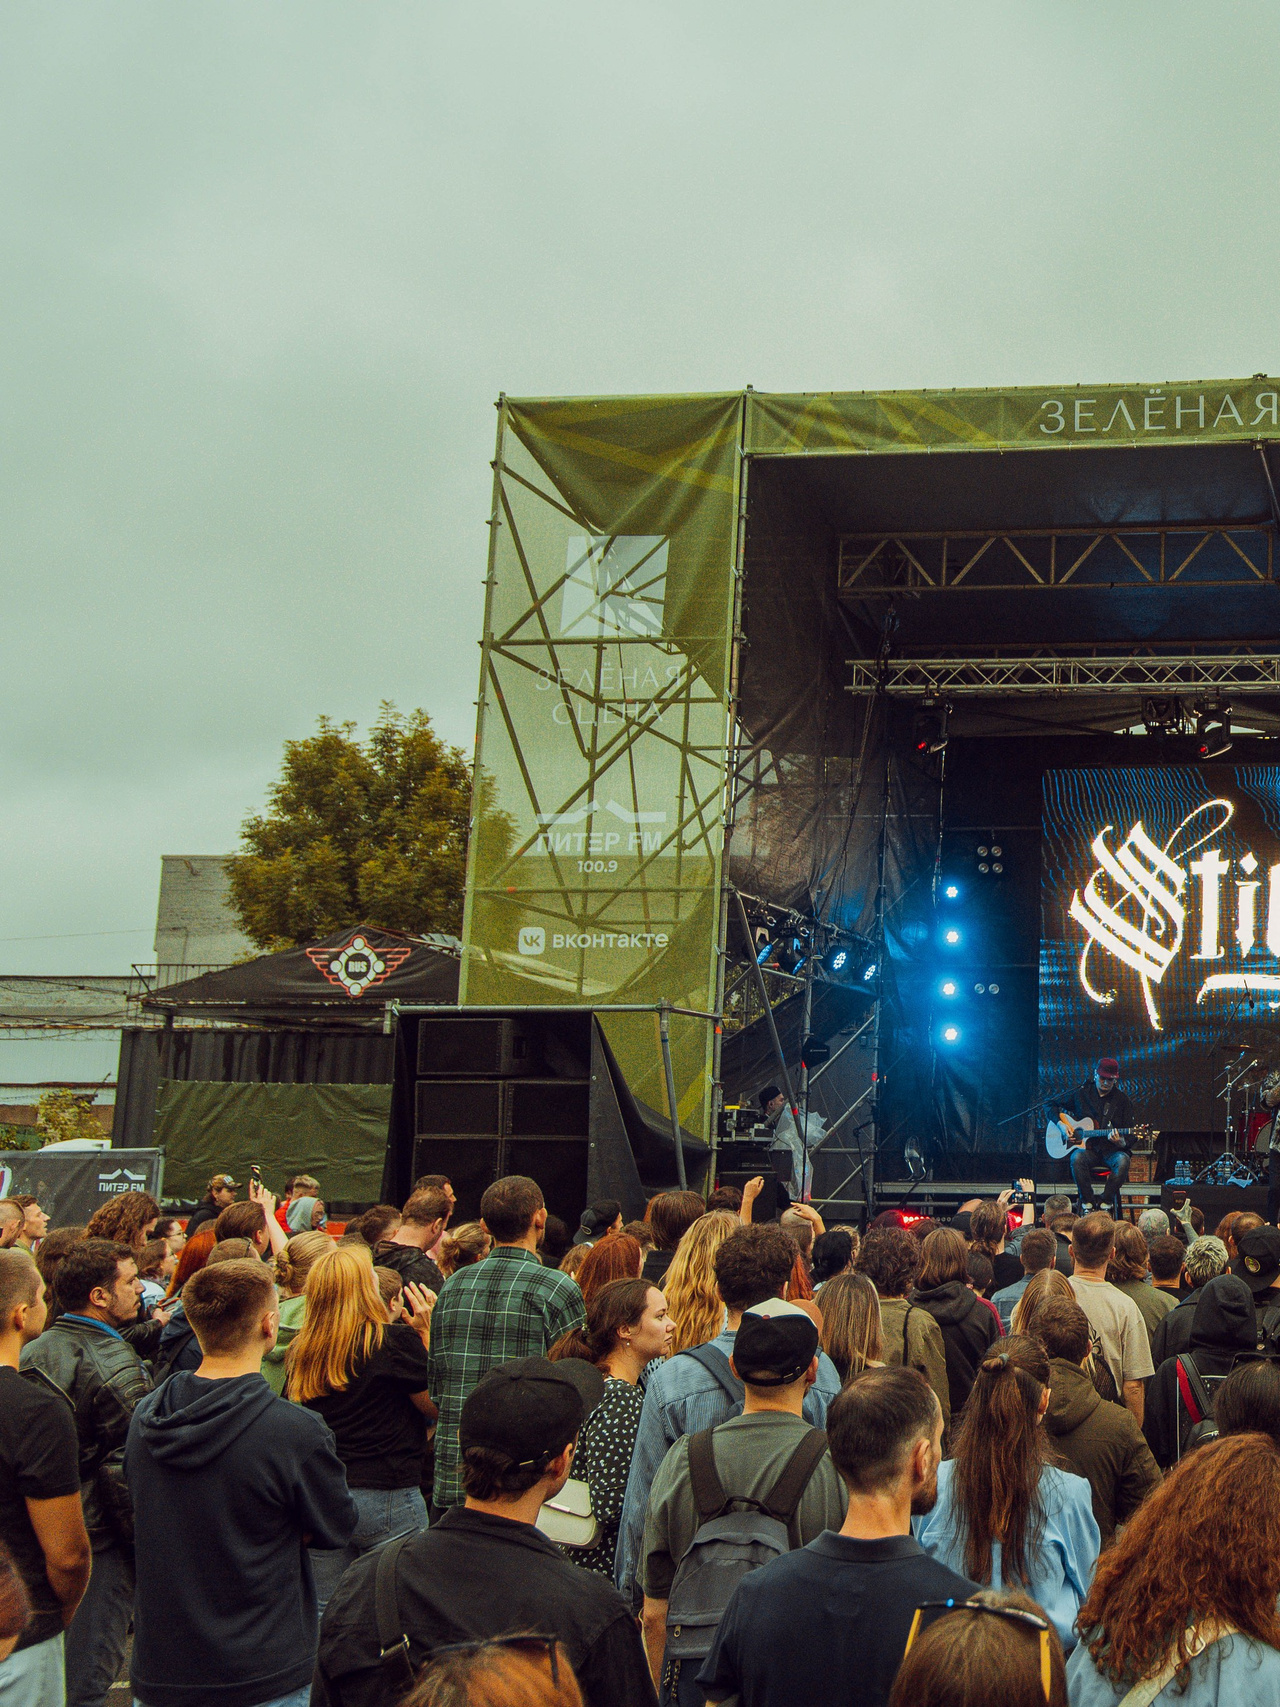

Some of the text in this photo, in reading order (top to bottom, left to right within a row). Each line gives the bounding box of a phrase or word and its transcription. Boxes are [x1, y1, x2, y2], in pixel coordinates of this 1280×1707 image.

[1039, 388, 1278, 433] ЗЕЛЁНАЯ
[535, 662, 681, 691] ЗЕЛЁНАЯ
[552, 700, 663, 726] СЦЕНА
[536, 831, 662, 852] ПИТЕР FM
[577, 860, 618, 873] 100.9
[98, 1182, 130, 1192] ПИТЕР
